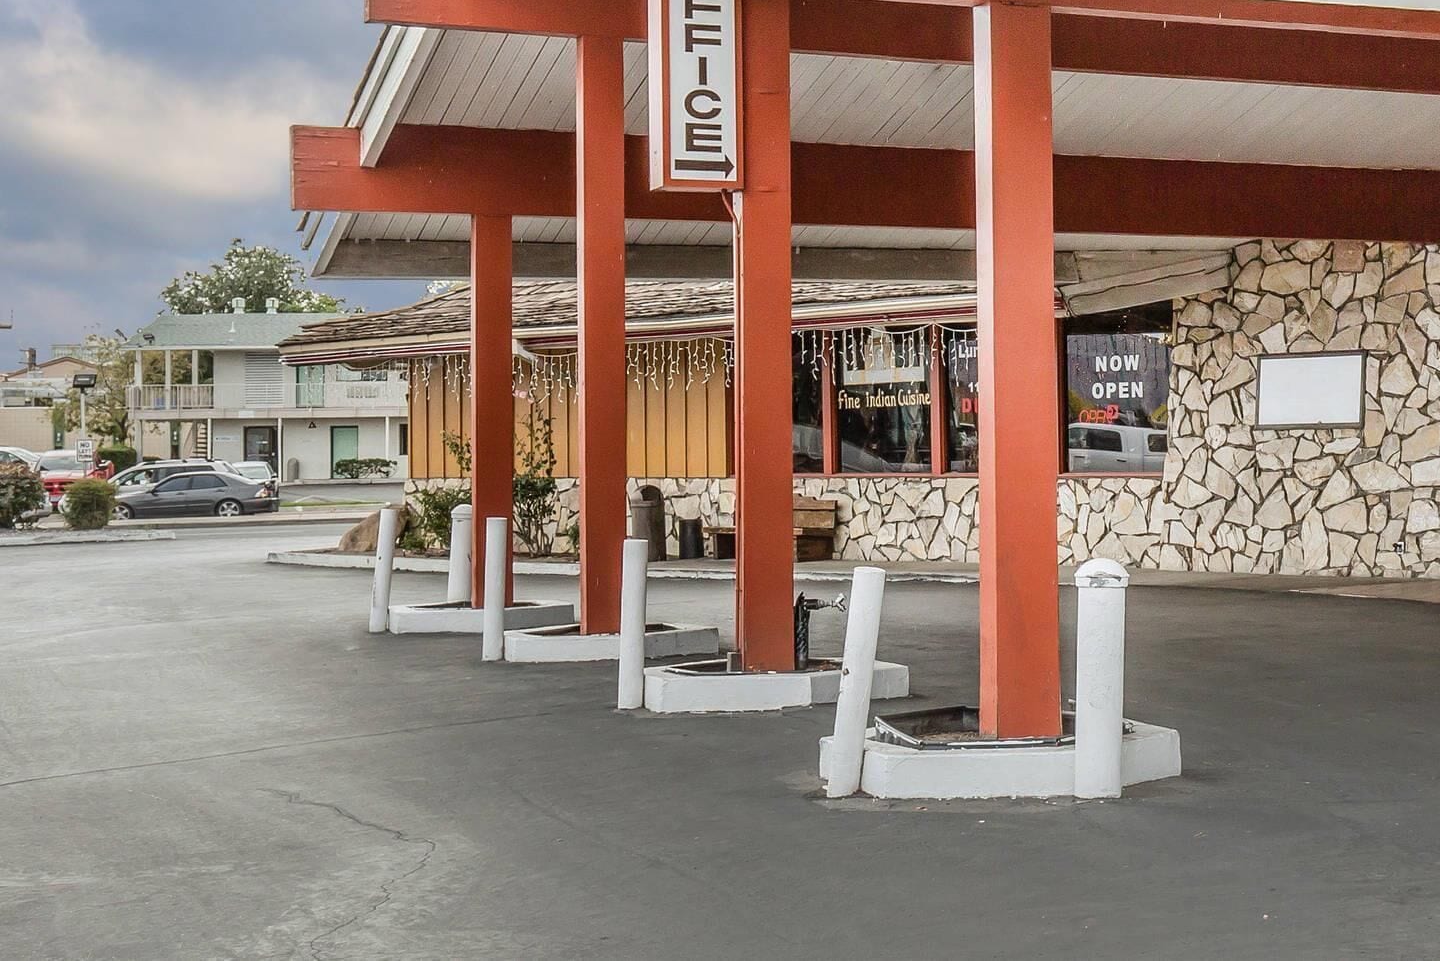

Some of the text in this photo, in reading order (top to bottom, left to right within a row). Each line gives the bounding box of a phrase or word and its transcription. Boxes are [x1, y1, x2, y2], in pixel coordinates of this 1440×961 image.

[1095, 354, 1139, 372] NOW
[897, 389, 931, 406] Cuisine
[1092, 381, 1144, 399] OPEN
